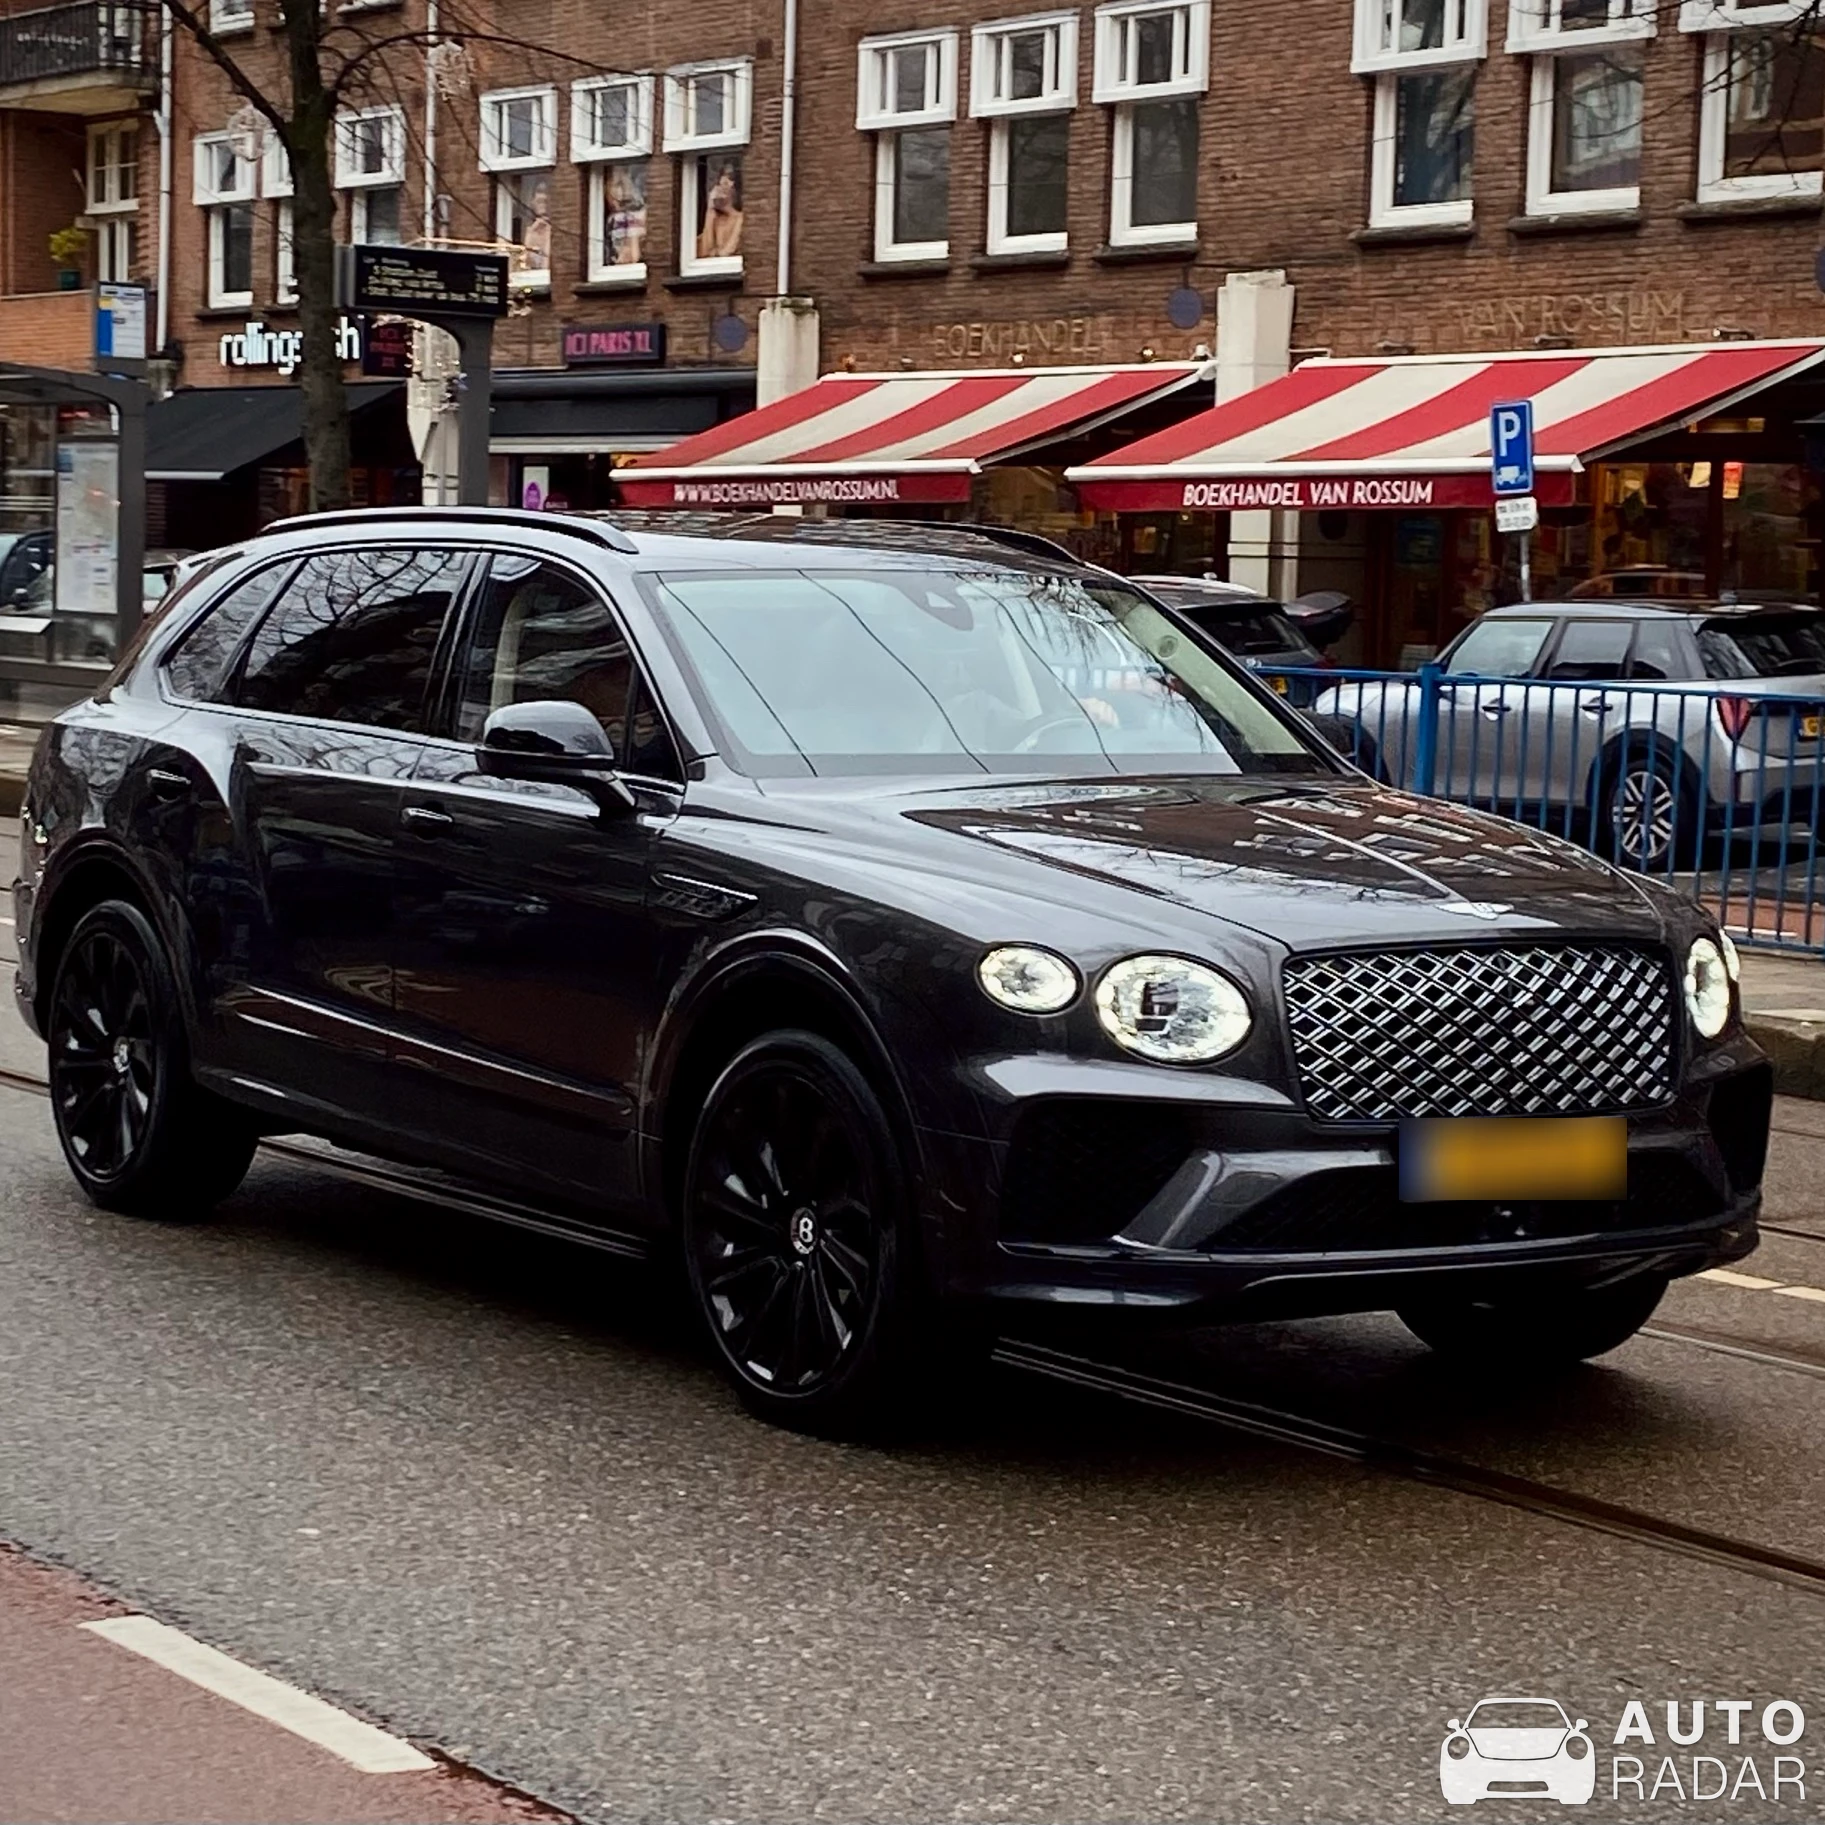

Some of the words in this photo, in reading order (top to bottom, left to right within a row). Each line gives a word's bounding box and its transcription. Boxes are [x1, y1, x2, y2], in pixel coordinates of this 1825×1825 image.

[589, 331, 631, 354] PARIS
[1498, 411, 1521, 457] P
[1182, 483, 1304, 506] BOEKHANDEL
[1310, 481, 1348, 505] VAN
[1352, 480, 1433, 505] ROSSUM
